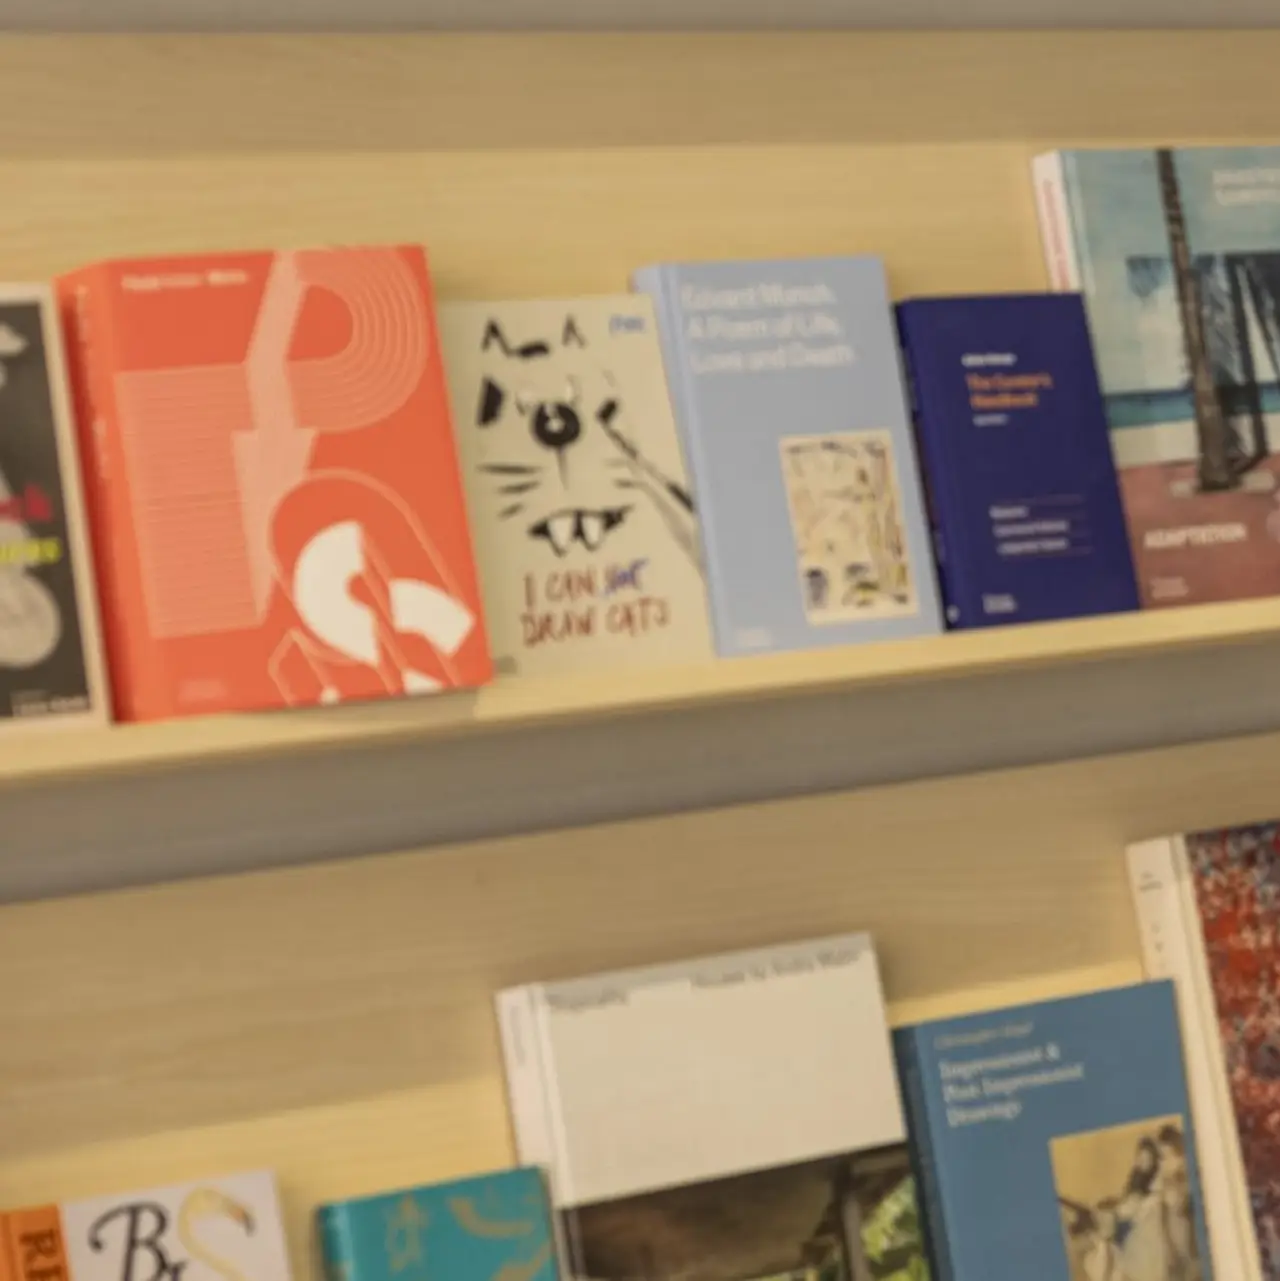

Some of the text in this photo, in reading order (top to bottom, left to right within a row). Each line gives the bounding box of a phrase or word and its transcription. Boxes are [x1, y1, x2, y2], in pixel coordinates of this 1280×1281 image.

[522, 572, 536, 609] I
[545, 566, 597, 604] CAN
[520, 605, 596, 649] DRAW
